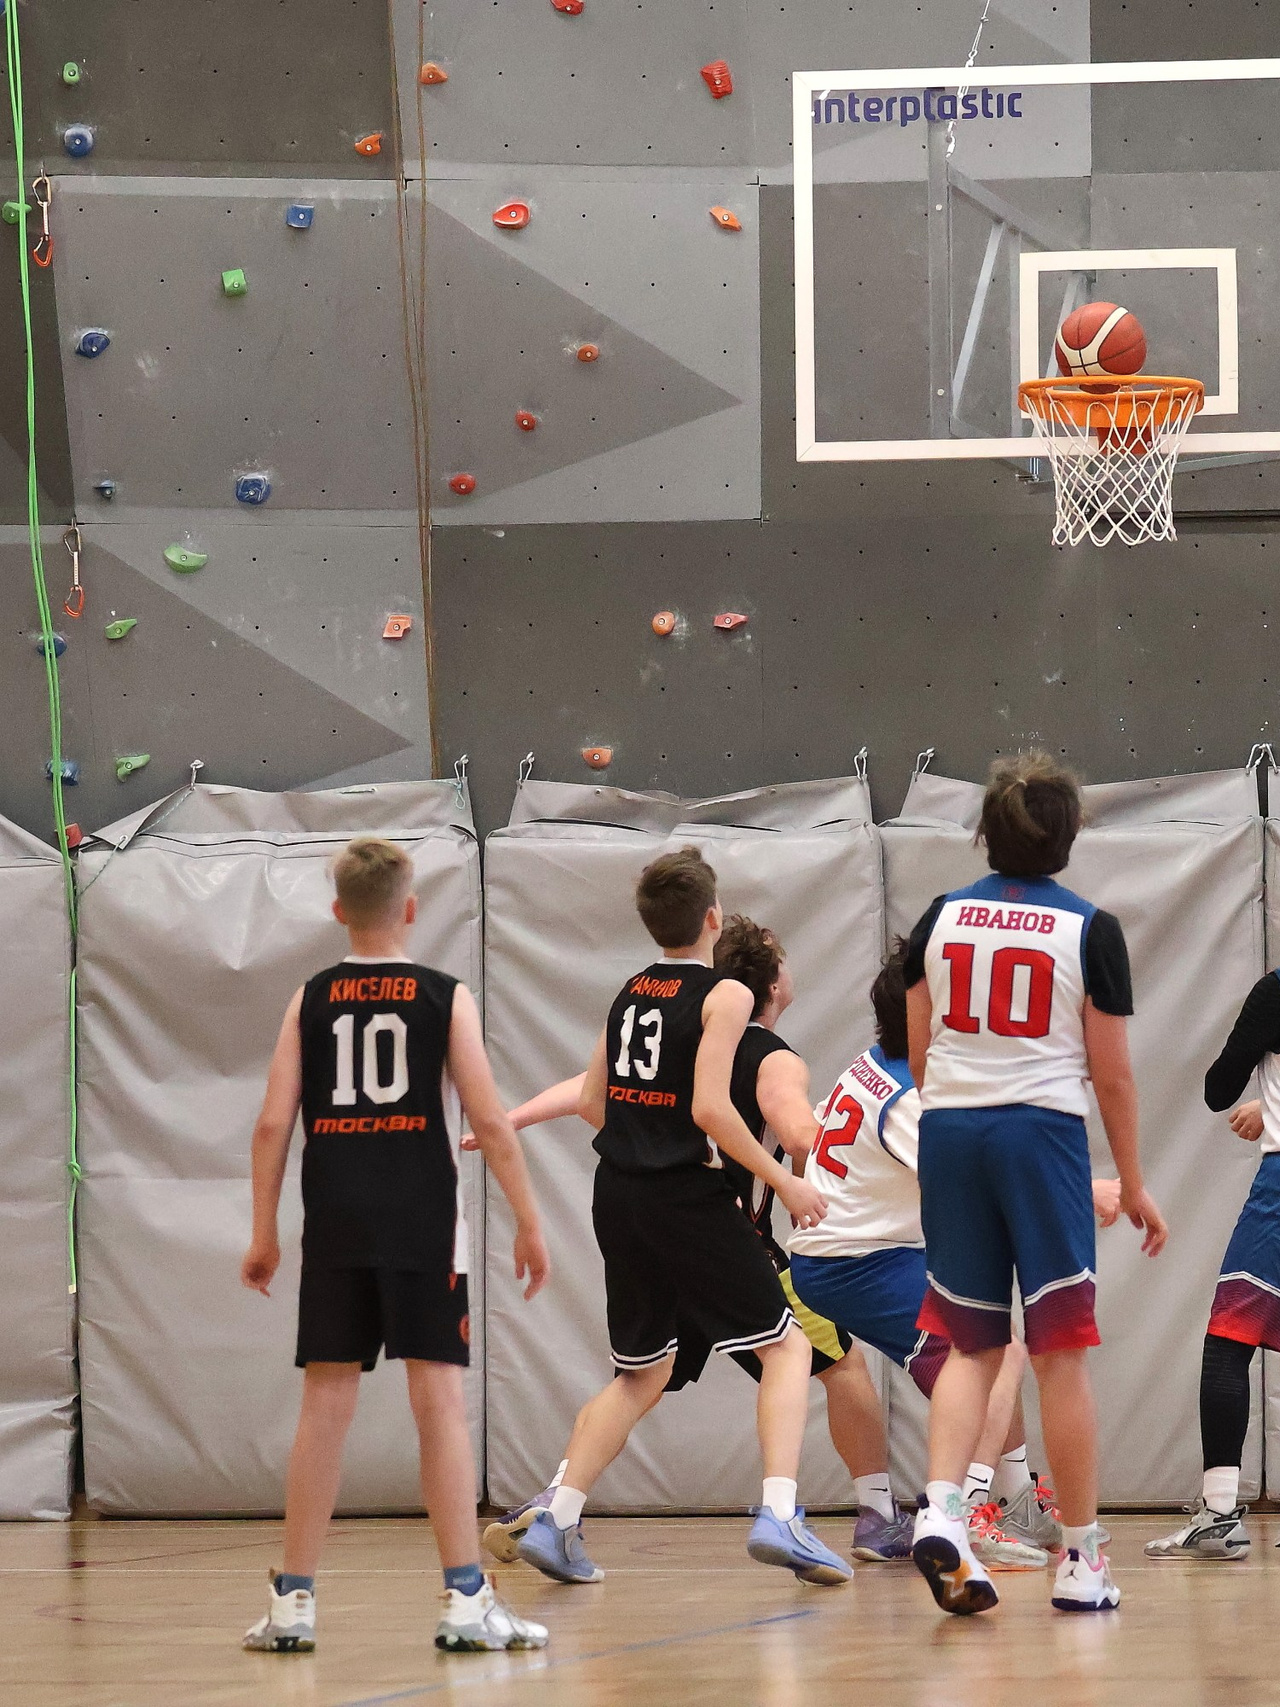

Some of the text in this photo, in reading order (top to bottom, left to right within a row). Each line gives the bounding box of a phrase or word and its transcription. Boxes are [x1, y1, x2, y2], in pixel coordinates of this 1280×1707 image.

[813, 87, 1023, 127] interplastic
[956, 906, 1056, 934] ИВАНОВ
[329, 976, 418, 1002] КИСЕЛЕВ
[942, 942, 1055, 1038] 10
[332, 1012, 410, 1106] 10
[614, 1004, 663, 1080] 13
